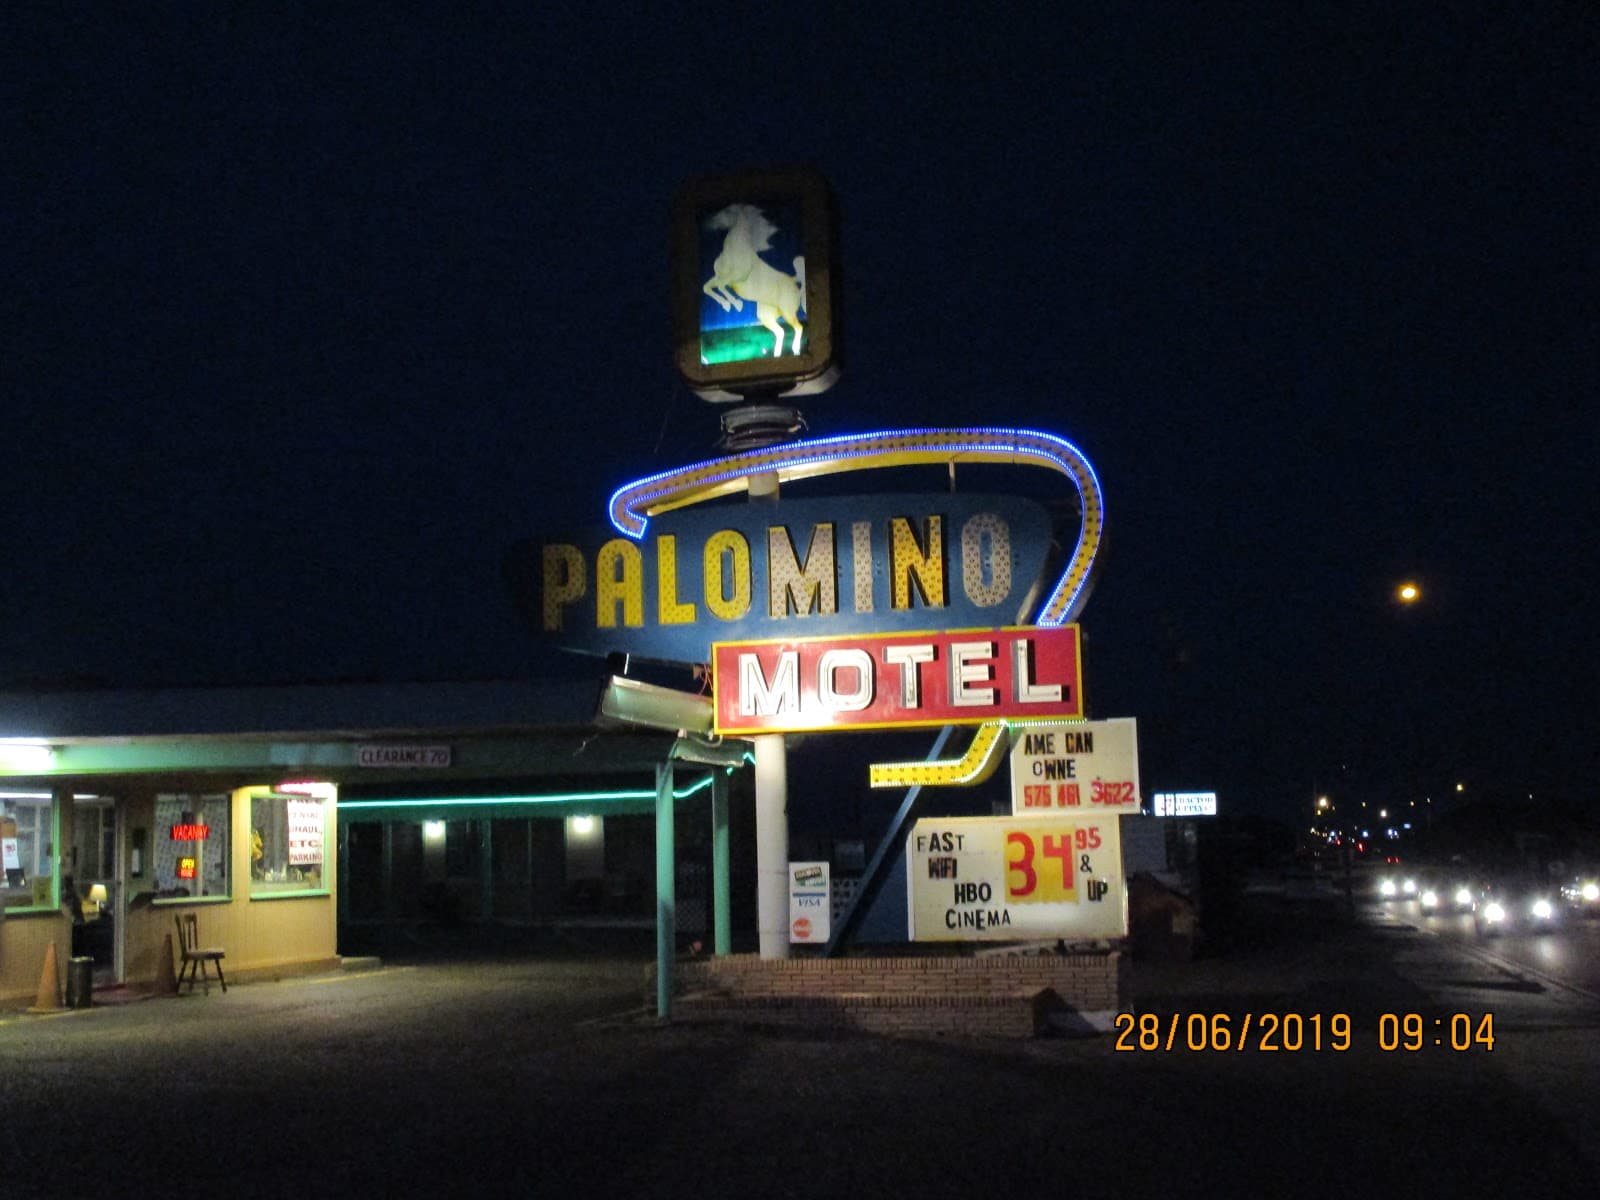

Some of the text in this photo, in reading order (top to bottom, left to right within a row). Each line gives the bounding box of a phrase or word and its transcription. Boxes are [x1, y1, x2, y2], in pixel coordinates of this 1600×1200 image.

[542, 512, 1012, 632] PALOMINO
[737, 638, 1063, 717] MOTEL
[1024, 731, 1094, 755] AME CAN
[1032, 759, 1076, 780] OWNE
[917, 831, 965, 852] FAST
[1007, 827, 1102, 897] 34 95
[1080, 854, 1093, 874] &
[954, 882, 992, 904] HBO
[1087, 878, 1109, 902] UP
[945, 908, 1011, 931] CINEMA
